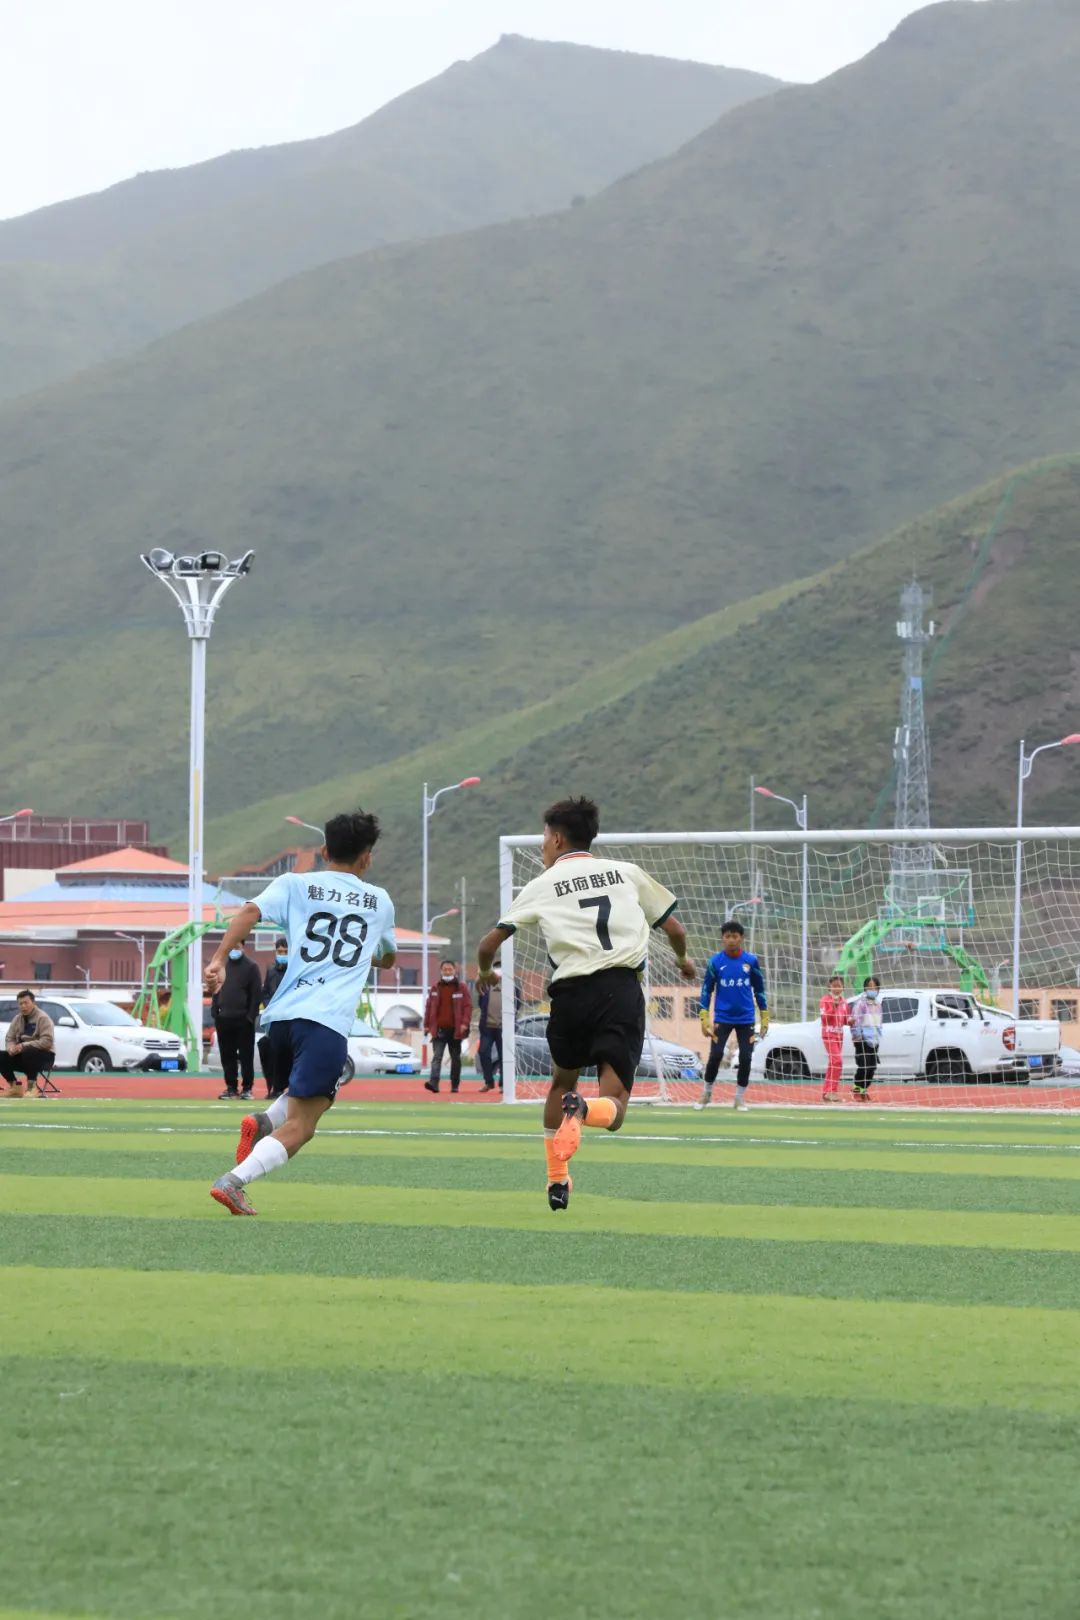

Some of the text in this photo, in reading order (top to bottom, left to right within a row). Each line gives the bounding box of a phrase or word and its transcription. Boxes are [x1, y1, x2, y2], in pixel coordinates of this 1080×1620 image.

[308, 884, 378, 912] 魅力名镇
[553, 870, 624, 897] 政府联队
[300, 911, 368, 968] 98
[578, 895, 613, 951] 7
